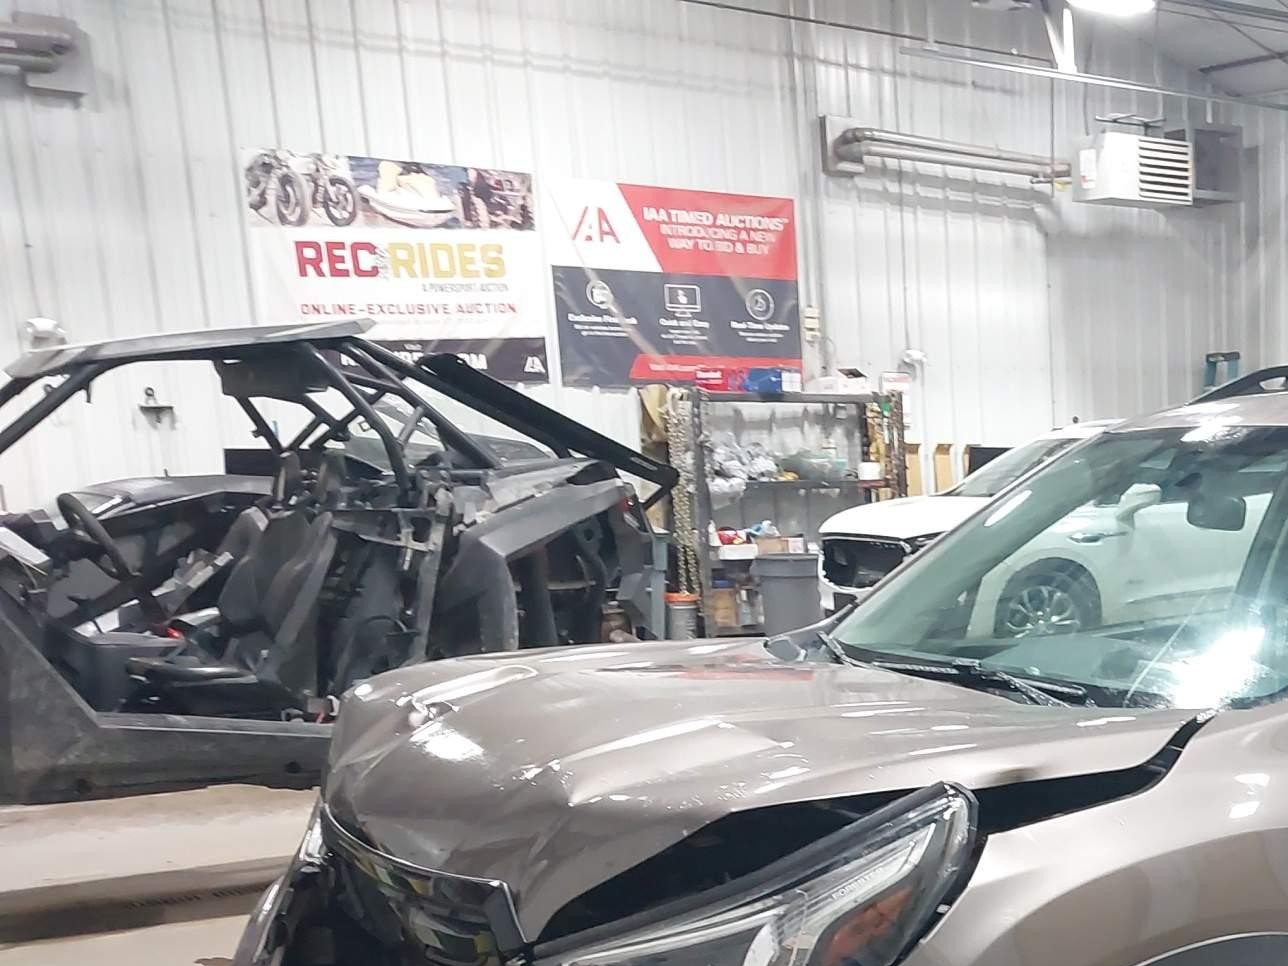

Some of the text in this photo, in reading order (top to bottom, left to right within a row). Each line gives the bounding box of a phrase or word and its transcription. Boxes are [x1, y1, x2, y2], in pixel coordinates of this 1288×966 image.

[642, 207, 667, 222] IAA
[668, 209, 714, 225] TIMED
[660, 224, 778, 243] INTRODUCING A NEW
[668, 238, 695, 250] WAY
[696, 239, 713, 251] TO
[735, 242, 745, 254] &
[746, 242, 770, 255] BUY
[294, 241, 507, 279] REC RIDES
[300, 302, 518, 315] ONLINE-EXCLUSIVE AUCTION
